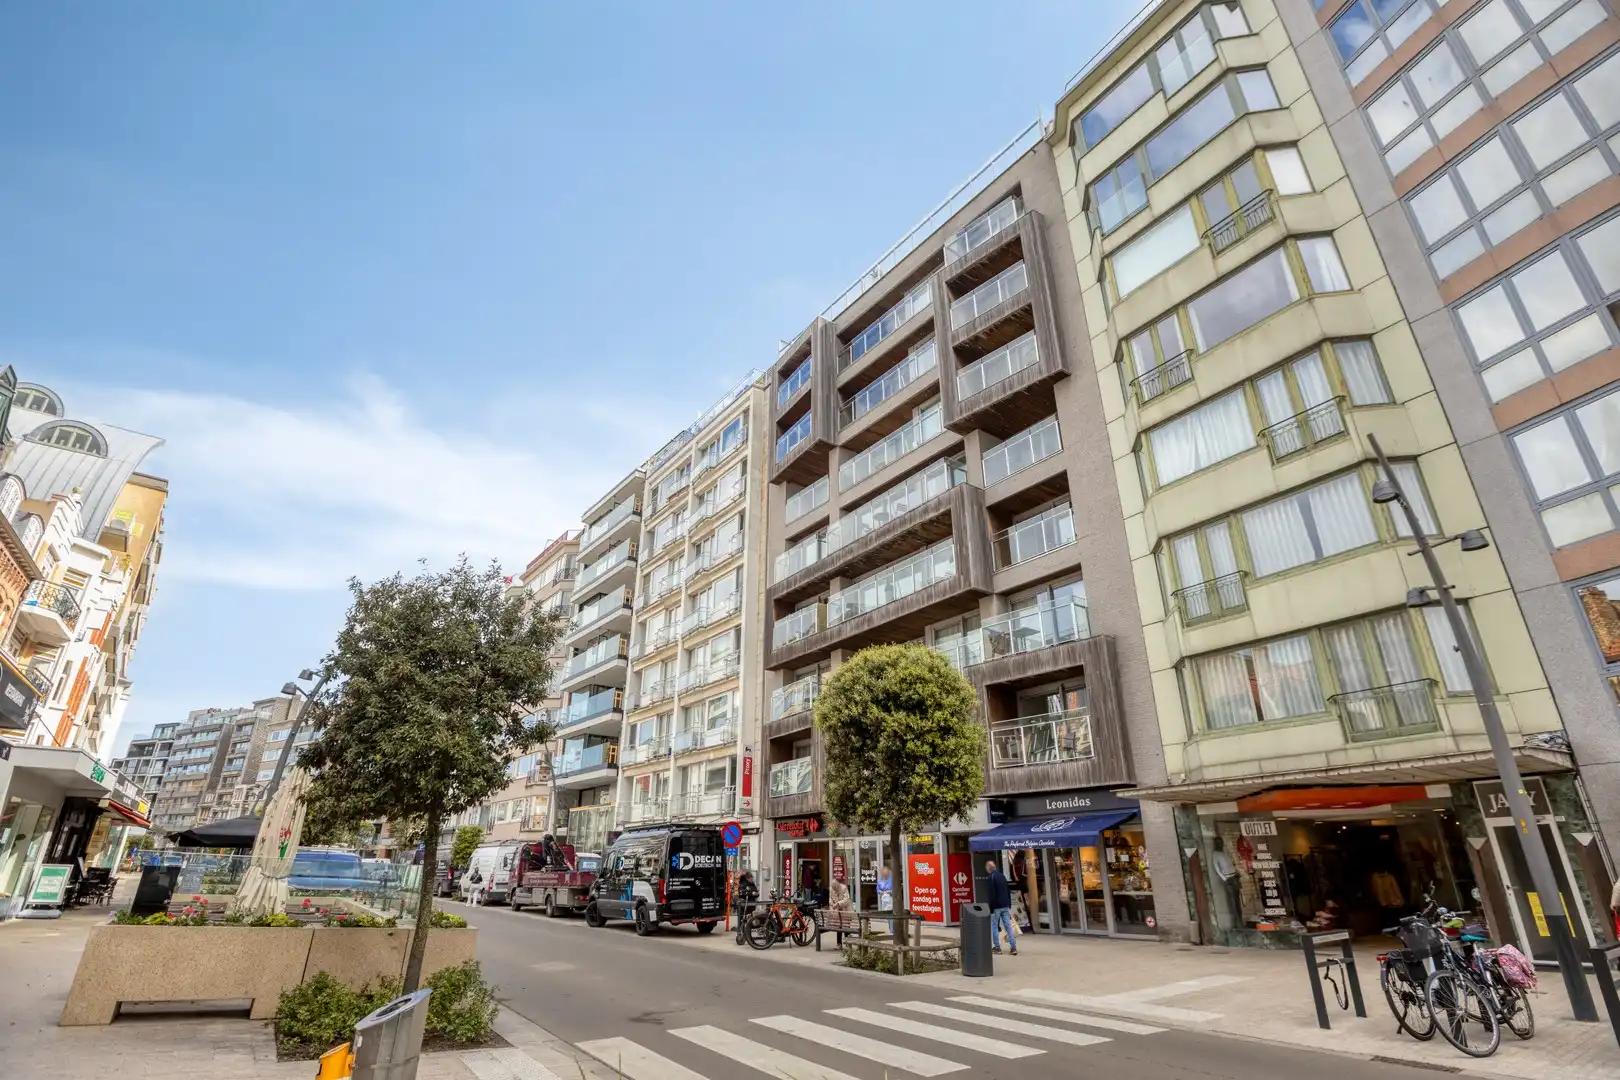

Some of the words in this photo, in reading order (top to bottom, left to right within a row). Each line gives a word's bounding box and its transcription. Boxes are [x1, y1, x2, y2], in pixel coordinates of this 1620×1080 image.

[1046, 796, 1091, 810] Leonidas
[1487, 790, 1537, 813] JAY
[1244, 822, 1273, 835] OUTLET
[914, 886, 930, 895] Open
[929, 887, 937, 895] op
[912, 896, 932, 904] zondag
[912, 904, 942, 913] feestdagen
